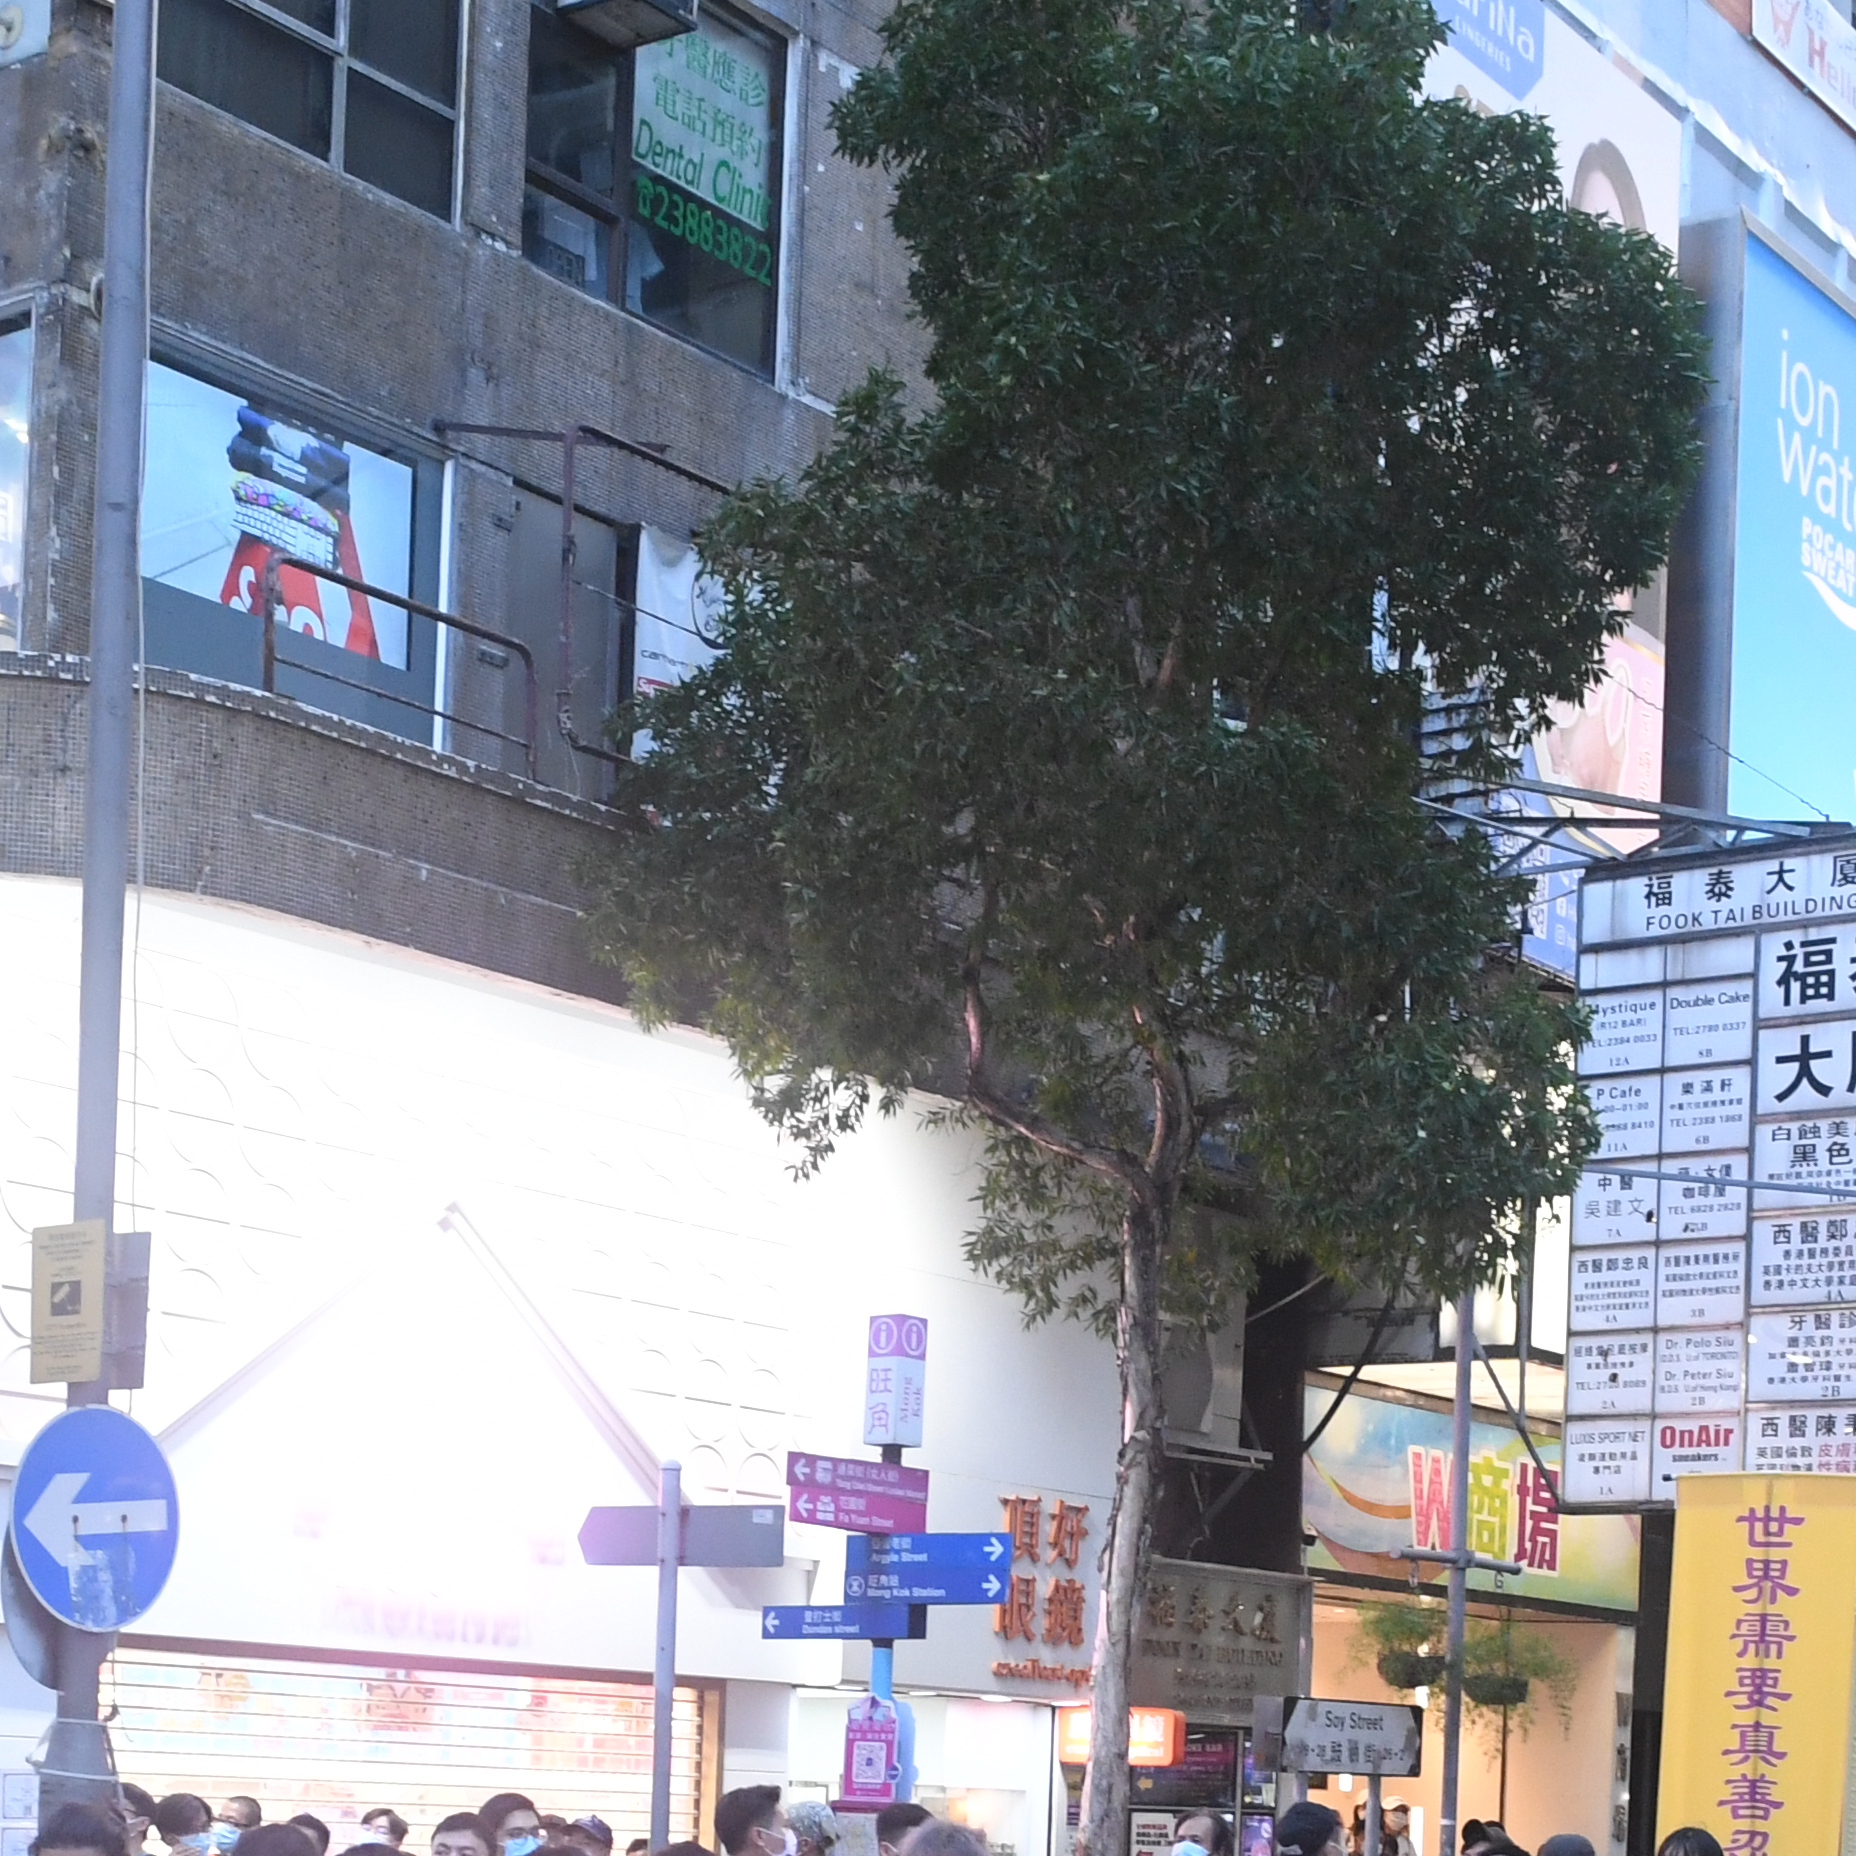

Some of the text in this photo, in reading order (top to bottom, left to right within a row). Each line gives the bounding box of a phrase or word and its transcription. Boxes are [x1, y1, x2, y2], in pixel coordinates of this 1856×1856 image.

[653, 73, 764, 168] 電話預約
[634, 118, 774, 232] Dental Clinic
[654, 184, 772, 287] 23883822
[1780, 328, 1841, 450] ion
[1801, 541, 1856, 598] SWEAT
[1646, 911, 1704, 931] FOOK
[1710, 907, 1745, 926] TAI
[1670, 992, 1750, 1010] Double Cake
[1609, 1085, 1642, 1100] Cafe
[1597, 1175, 1634, 1192] 中醫
[1665, 1338, 1682, 1350] Dr.
[1664, 1370, 1681, 1382] Dr.
[1683, 1367, 1713, 1381] Peter
[1821, 1385, 1842, 1397] 2B
[868, 1367, 893, 1435] 旺角
[1597, 1430, 1646, 1444] SPORT NET
[1660, 1424, 1735, 1449] OnAir
[1672, 1453, 1719, 1463] sneakers
[871, 1516, 894, 1528] Street
[999, 1495, 1090, 1570] 頂好
[901, 1552, 928, 1563] Street
[867, 1587, 946, 1599] Mong Kok Station
[994, 1574, 1086, 1648] 眼鏡
[1325, 1710, 1384, 1731] Soy Street
